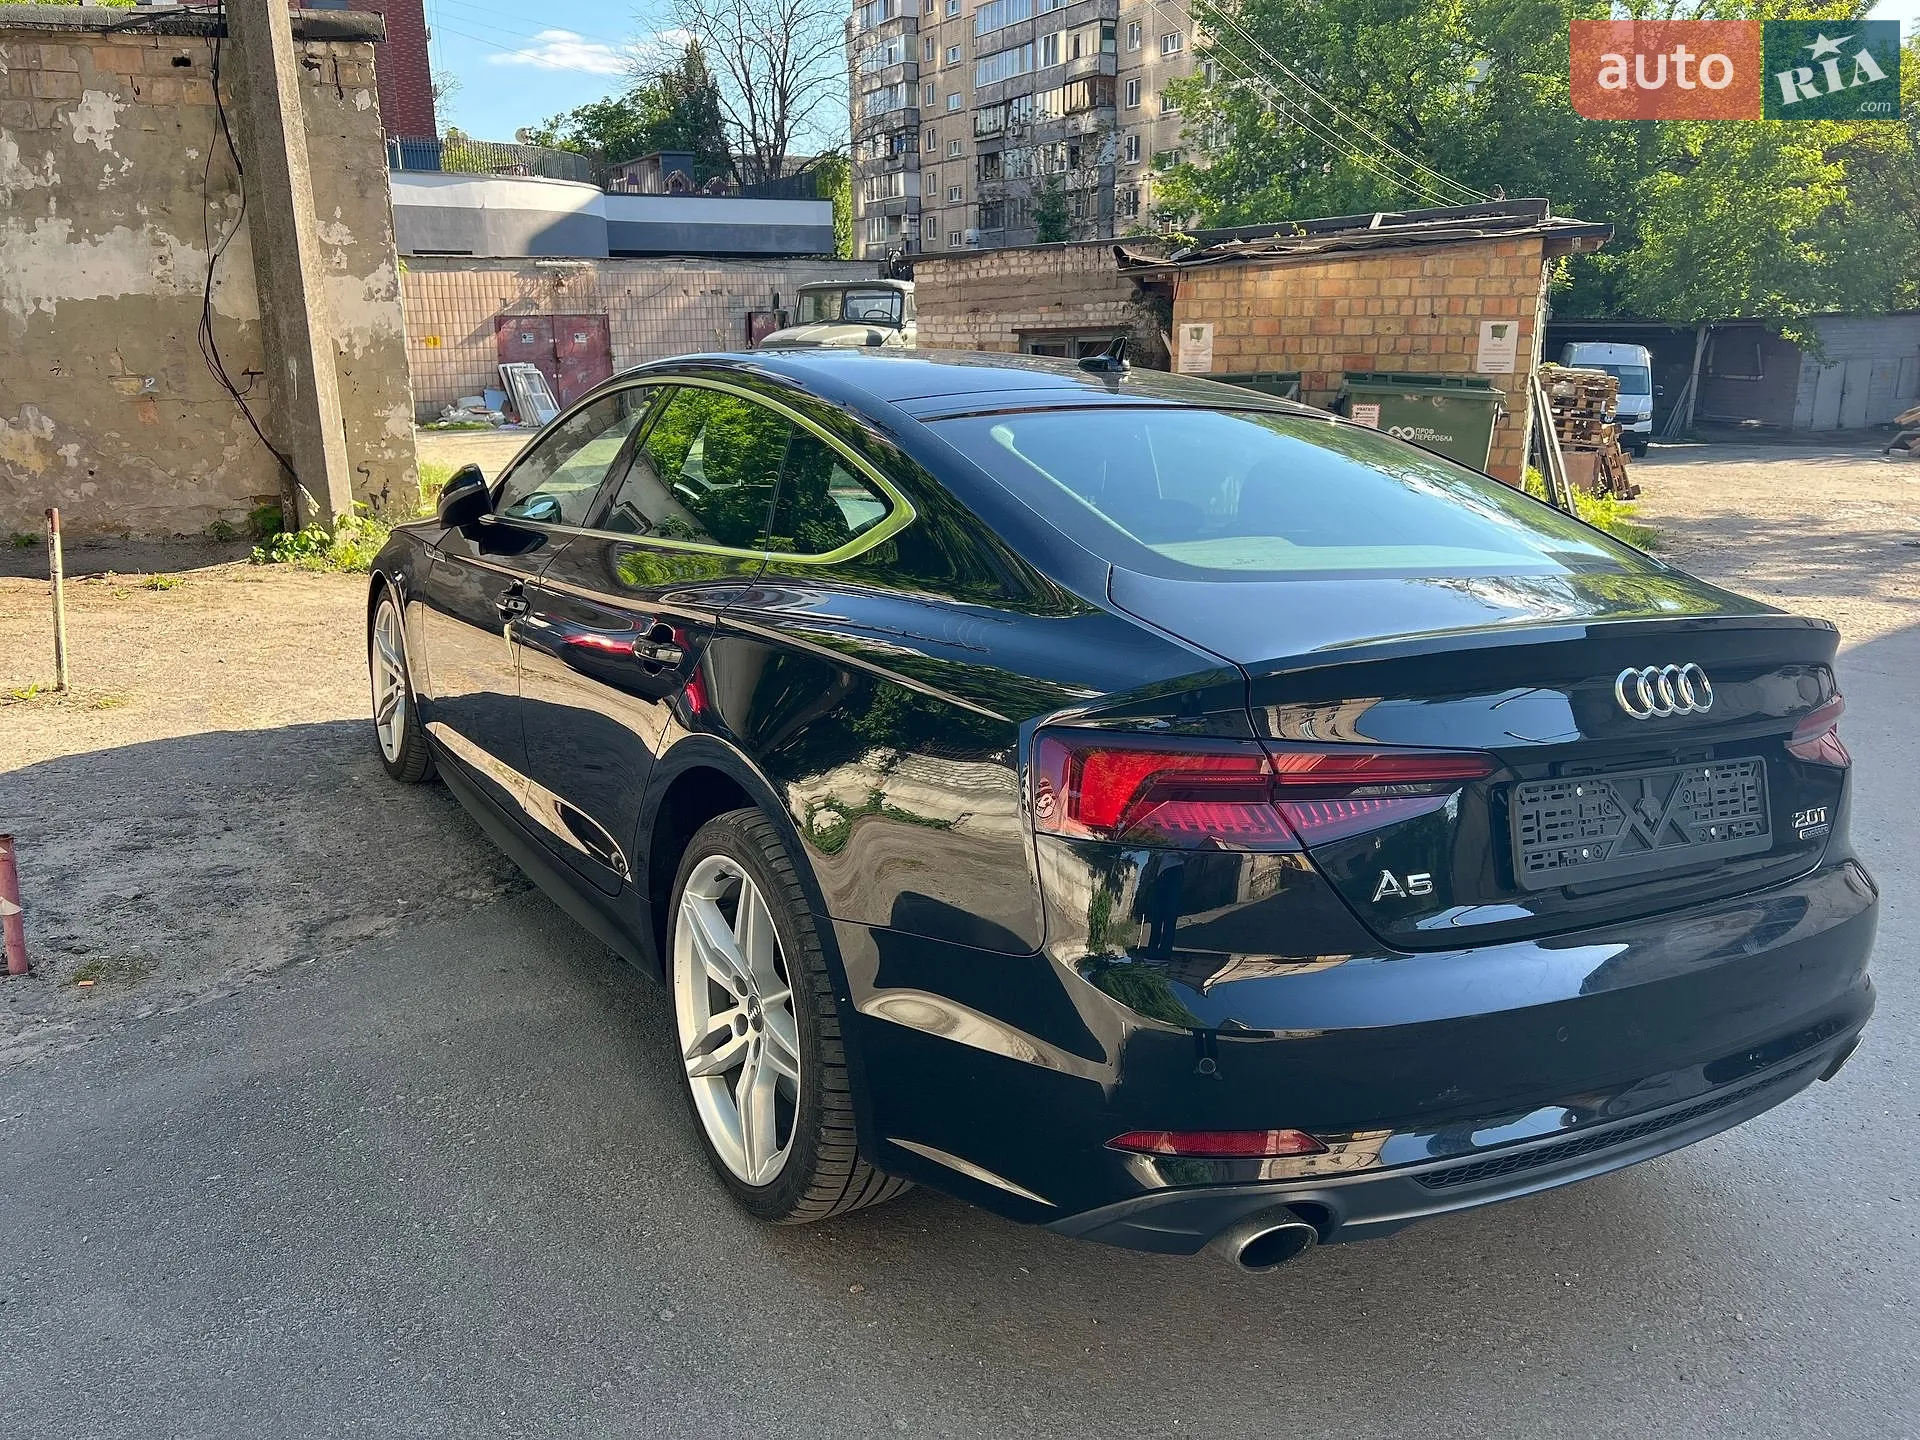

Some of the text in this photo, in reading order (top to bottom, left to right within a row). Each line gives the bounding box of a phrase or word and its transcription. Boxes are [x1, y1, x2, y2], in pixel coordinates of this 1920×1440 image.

[1415, 427, 1435, 435] ПРОФ
[1414, 434, 1453, 442] ПЕРЕРОБКА
[1372, 869, 1433, 903] A5
